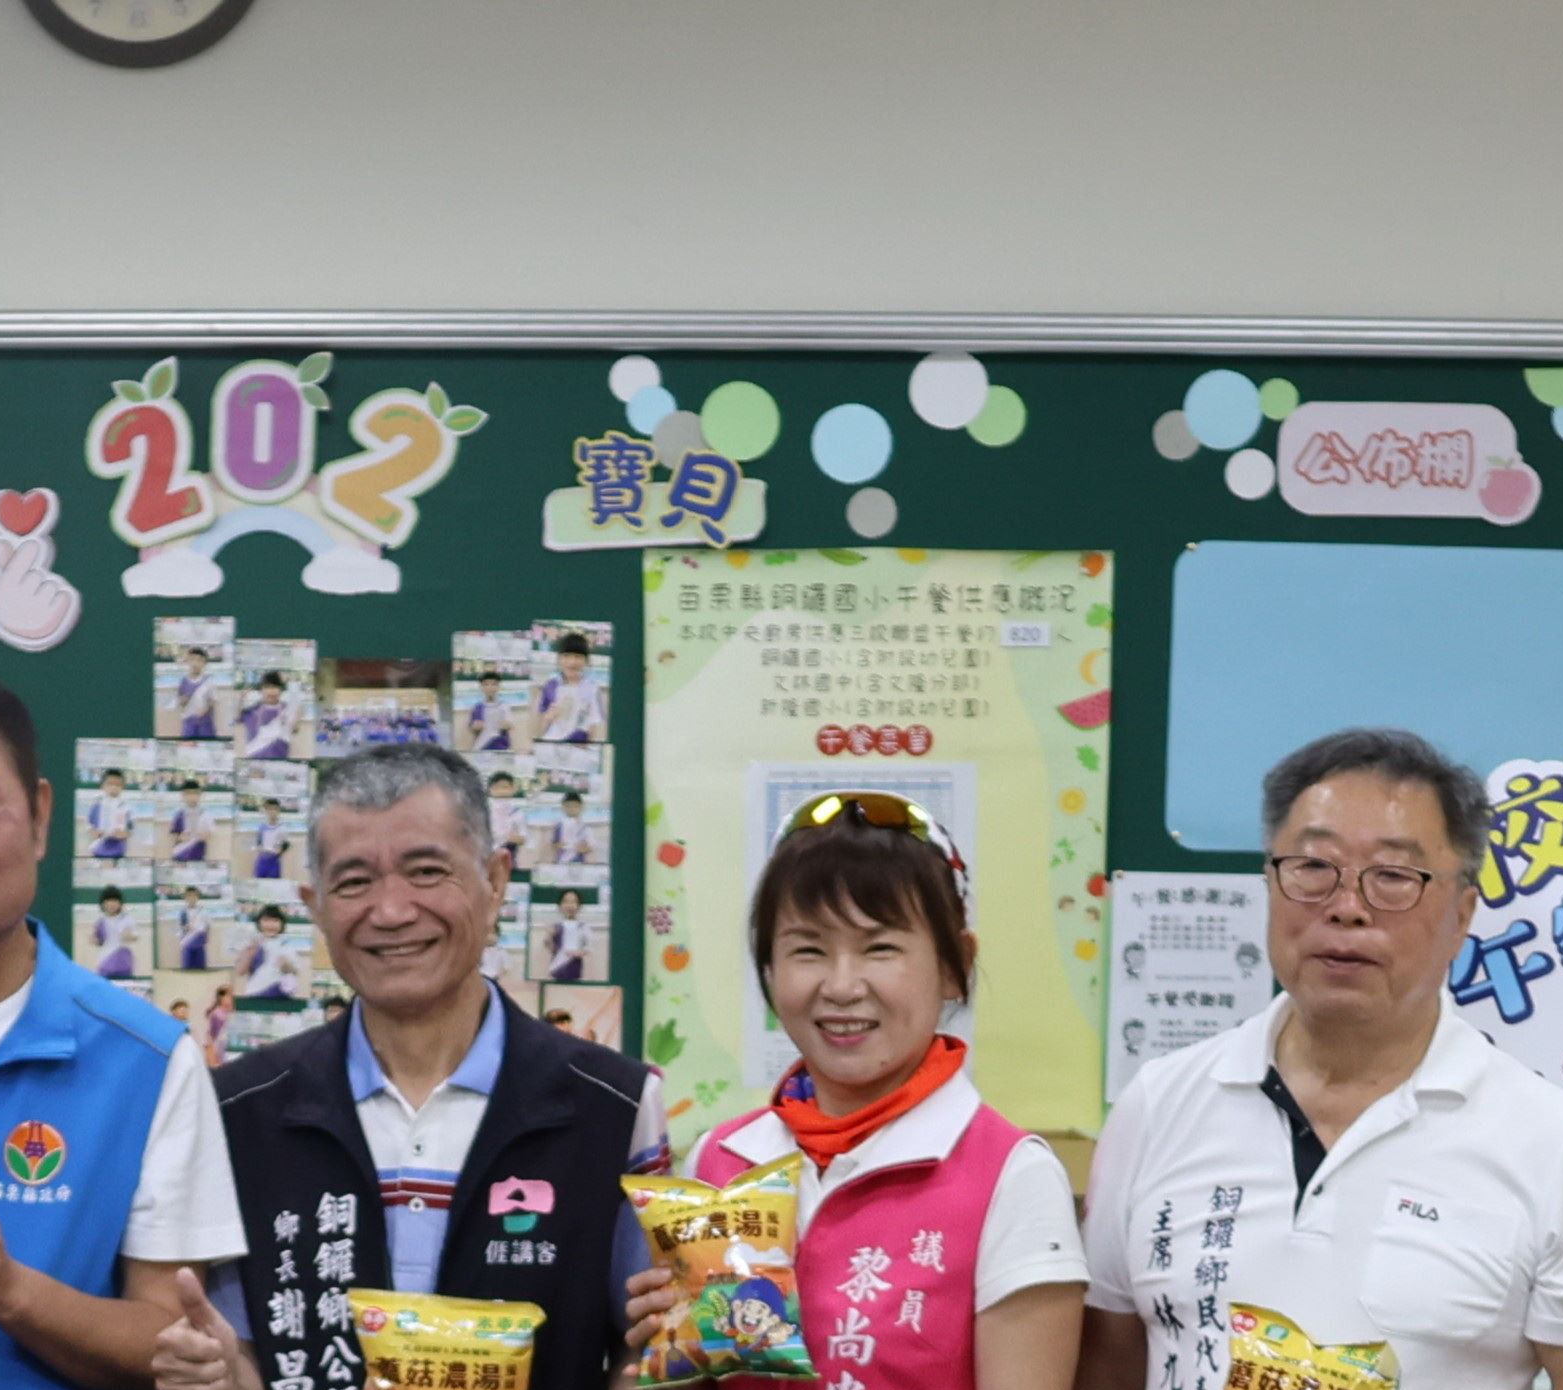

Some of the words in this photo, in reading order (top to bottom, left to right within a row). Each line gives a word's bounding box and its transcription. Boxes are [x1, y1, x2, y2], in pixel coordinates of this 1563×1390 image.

[100, 372, 456, 538] 202
[572, 430, 744, 549] 寶貝
[1294, 427, 1474, 493] 公佈欄
[1147, 1199, 1176, 1273] 主席
[1397, 1198, 1441, 1223] FILA
[892, 1228, 948, 1335] 議員
